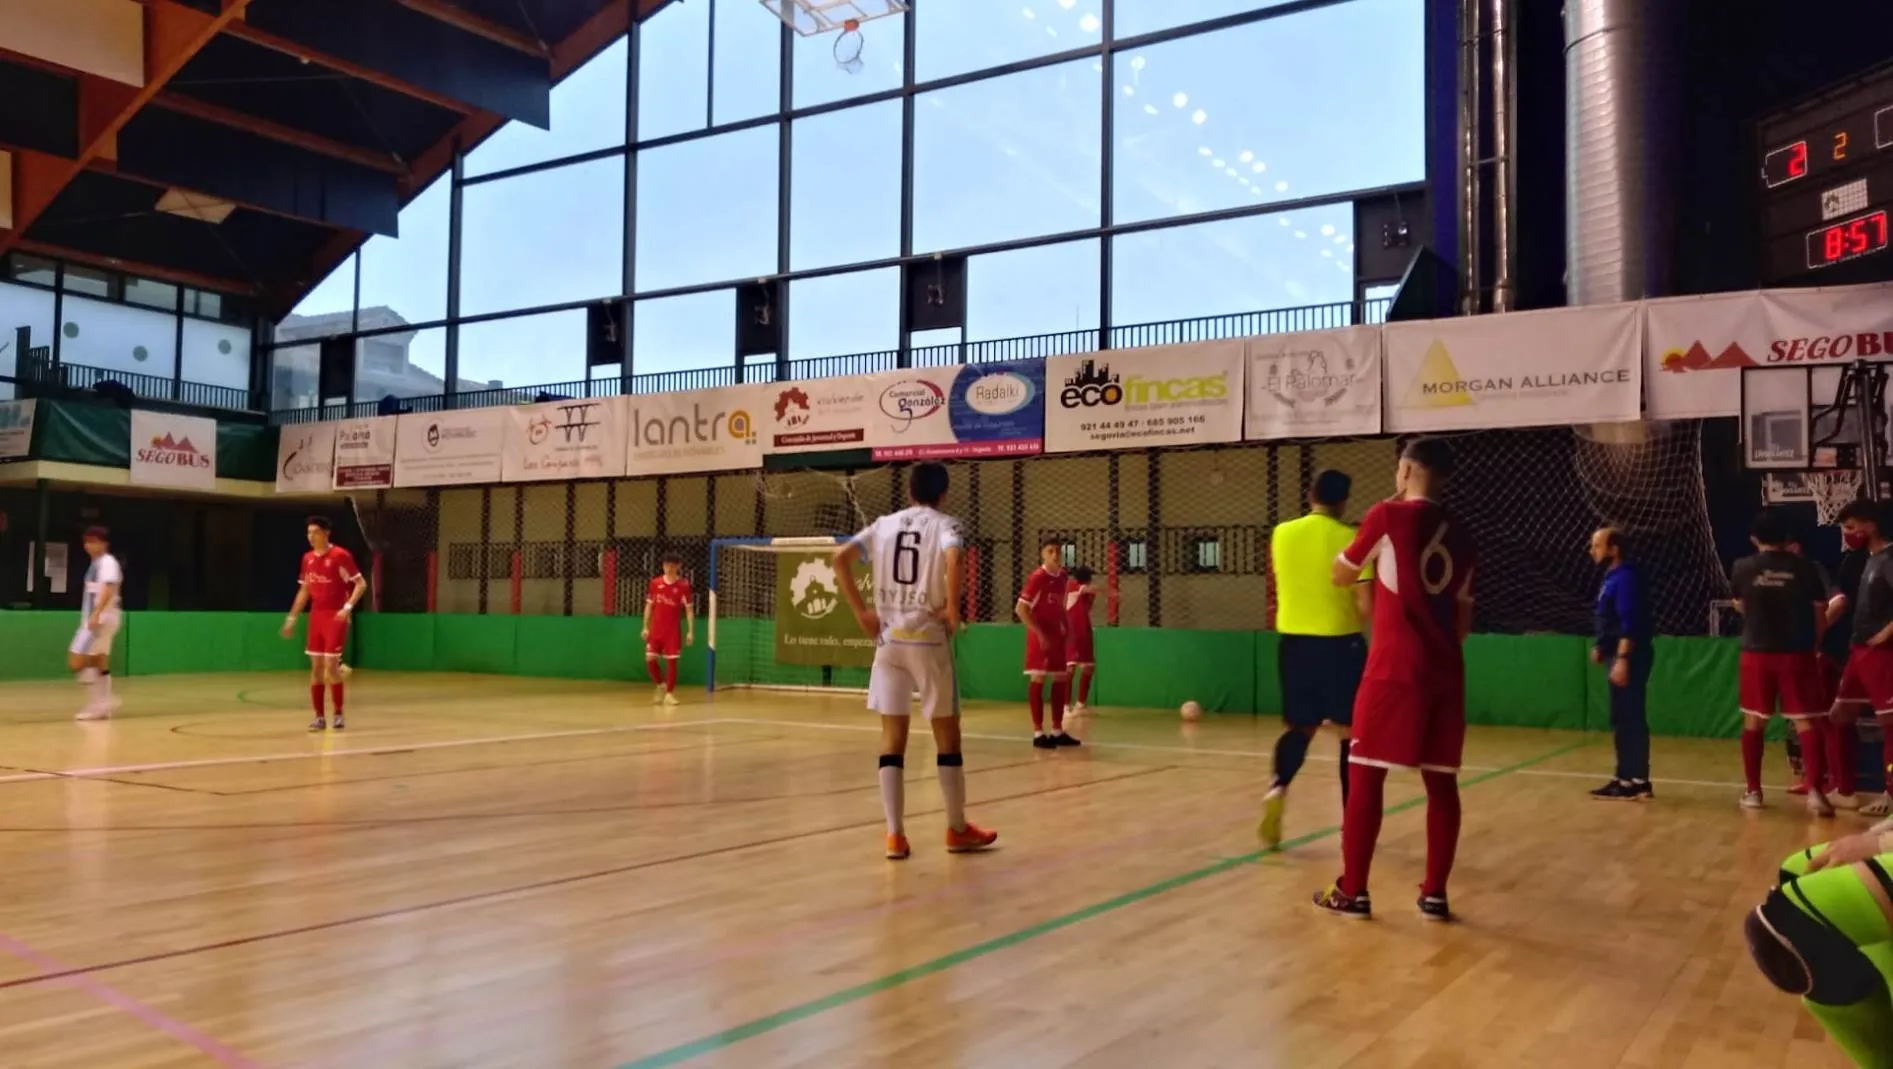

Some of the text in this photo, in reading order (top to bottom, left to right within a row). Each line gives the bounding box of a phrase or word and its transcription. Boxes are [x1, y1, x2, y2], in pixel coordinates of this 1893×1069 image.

[1787, 140, 1807, 177] 2
[1833, 131, 1848, 160] 2
[1822, 212, 1887, 261] 8:57
[975, 383, 1019, 401] Radalki
[1286, 373, 1354, 390] Palomar
[1422, 369, 1631, 394] MORGAN ALLIANCE
[633, 402, 751, 448] lantra
[1080, 422, 1097, 432] 921
[1127, 419, 1139, 428] 47
[135, 448, 210, 468] SEGOBUS
[893, 530, 922, 585] 6
[1418, 519, 1454, 595] 6
